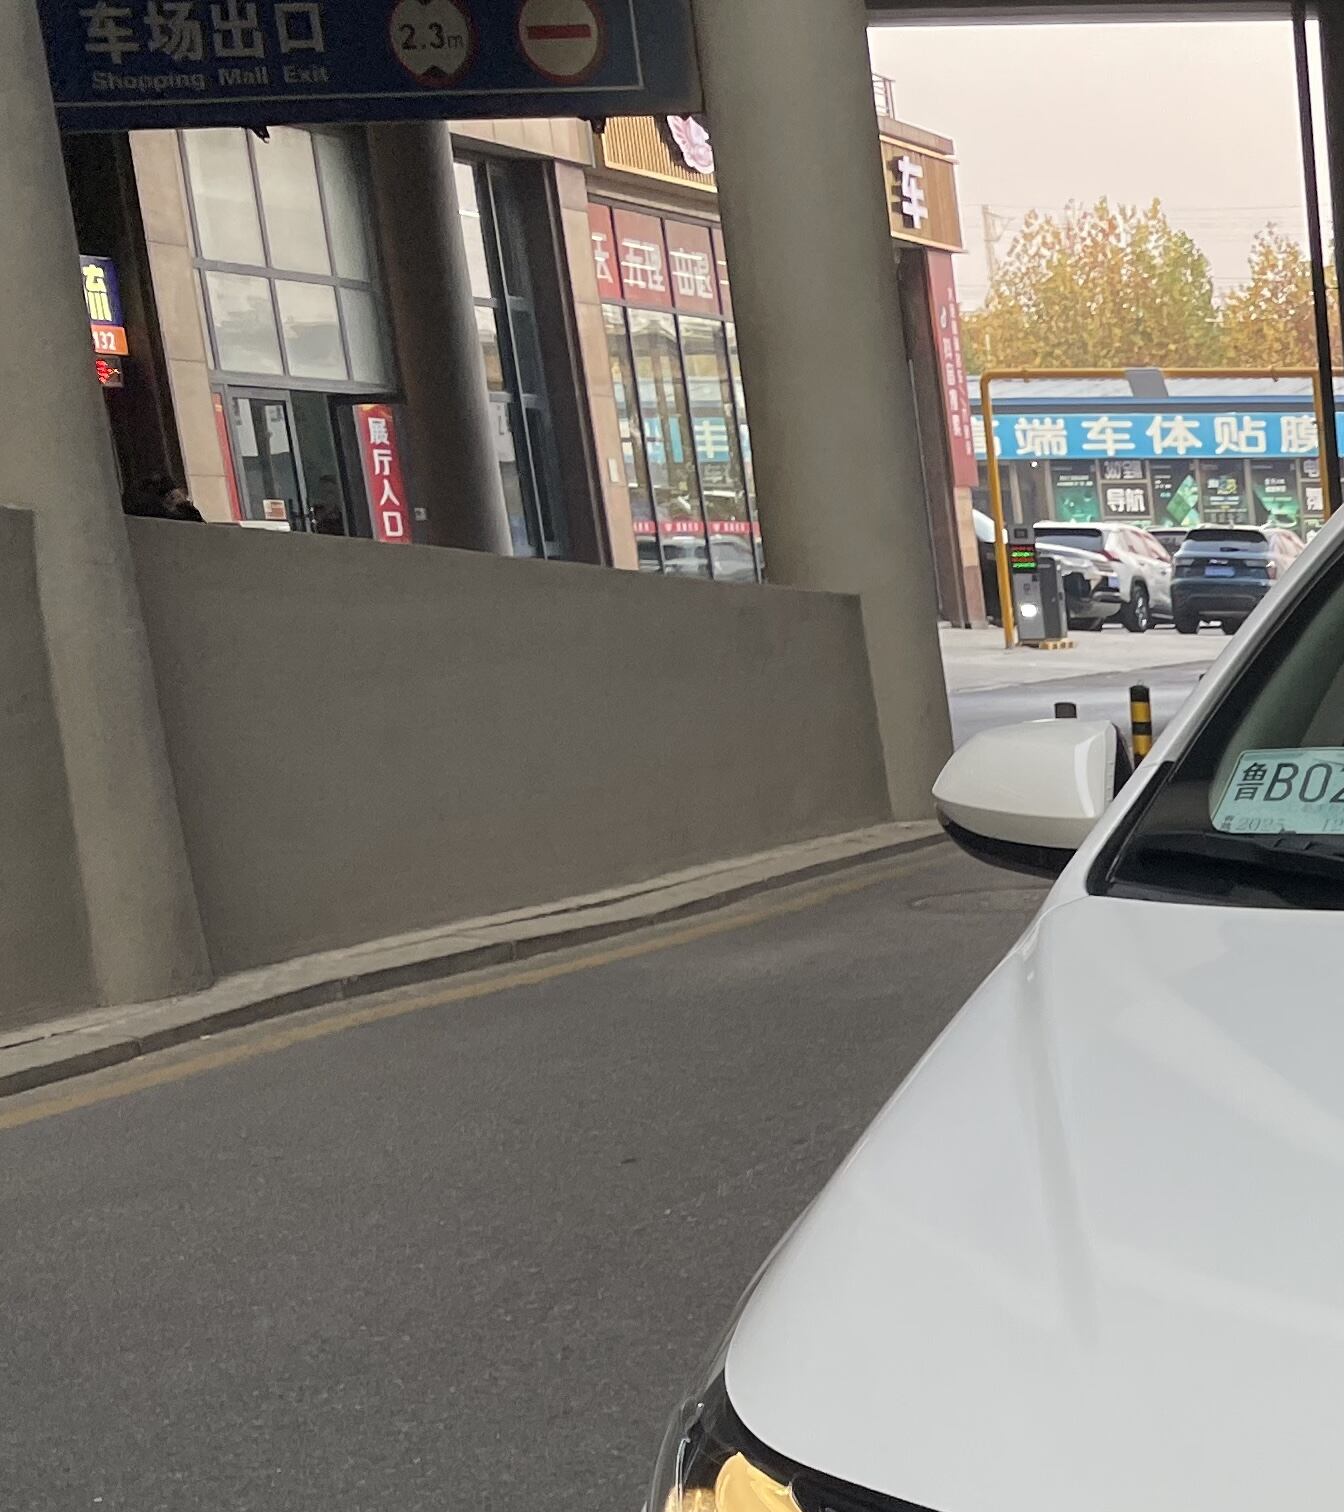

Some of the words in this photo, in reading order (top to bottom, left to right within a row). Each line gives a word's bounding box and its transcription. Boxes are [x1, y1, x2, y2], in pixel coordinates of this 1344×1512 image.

[79, 0, 326, 64] 车场出口
[400, 21, 464, 51] 2.3m
[92, 70, 207, 91] Shopping
[217, 66, 268, 86] Mall
[283, 64, 329, 83] Exit
[367, 417, 404, 537] 展厅入口
